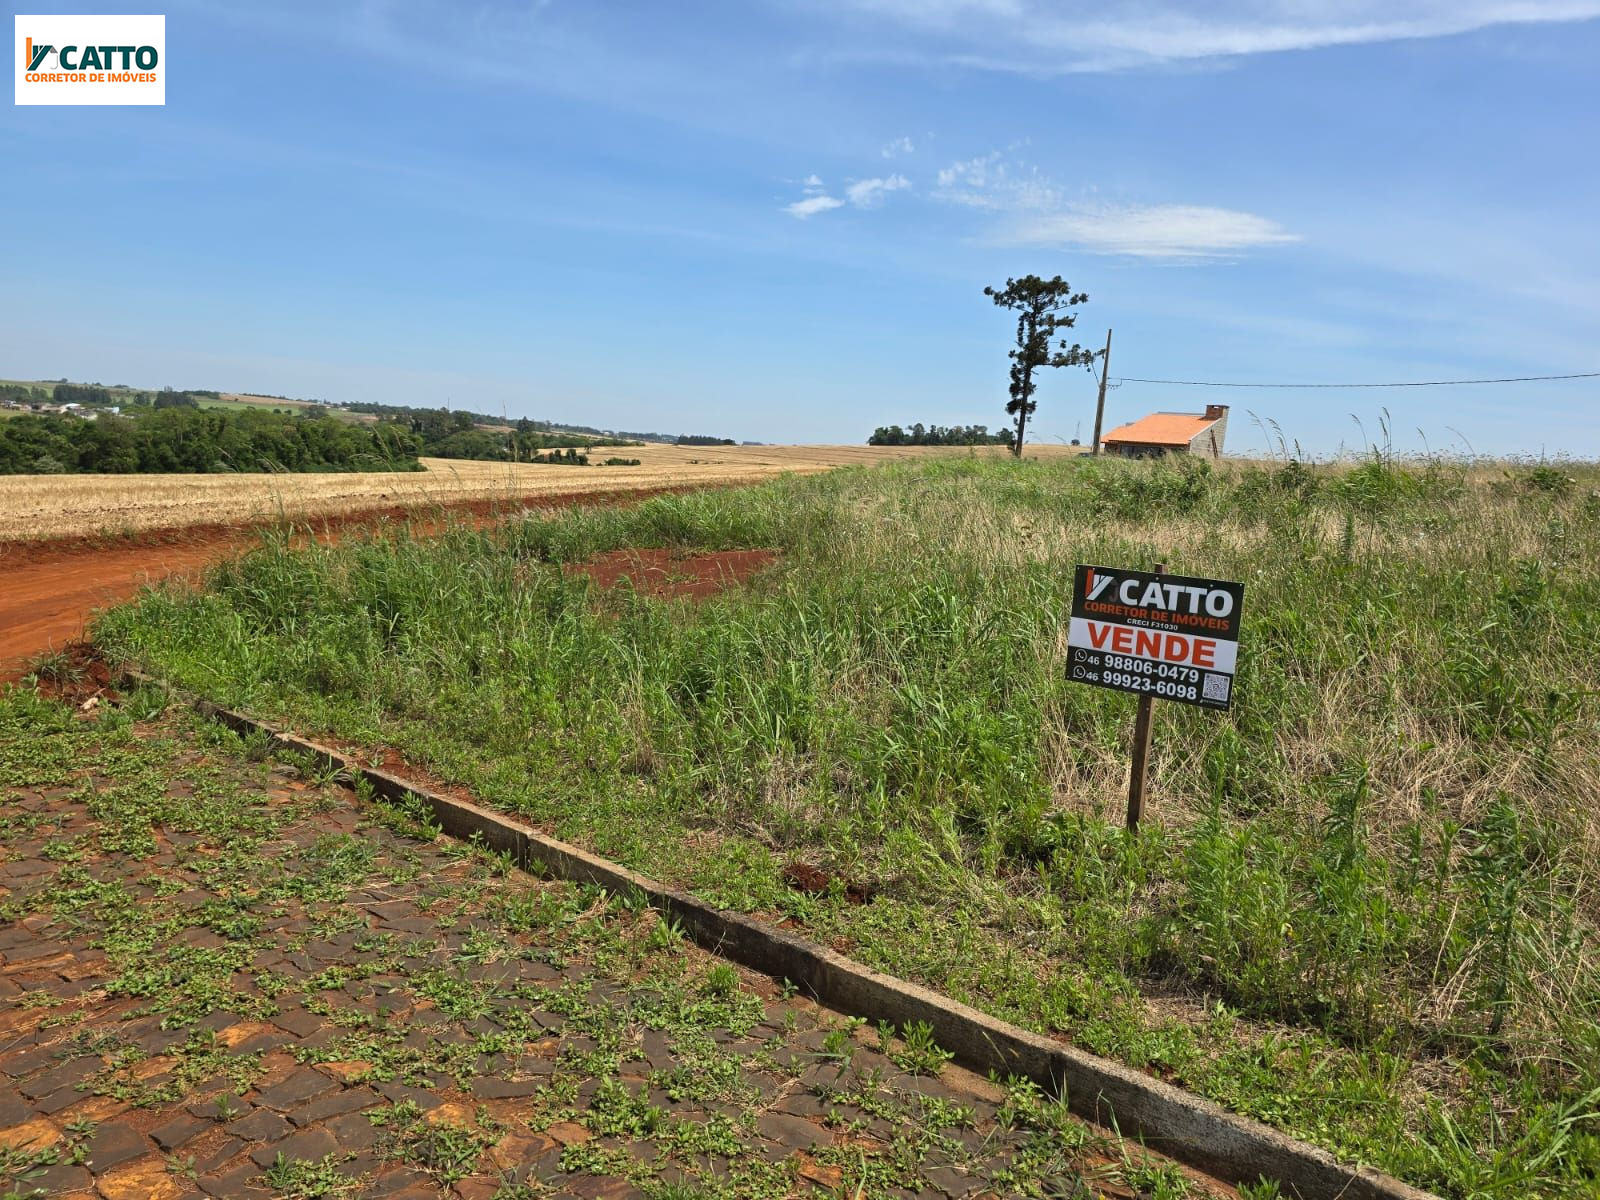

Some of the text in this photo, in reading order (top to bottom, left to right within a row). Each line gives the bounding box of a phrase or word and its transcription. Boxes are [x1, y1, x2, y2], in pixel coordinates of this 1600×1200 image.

[1119, 579, 1233, 617] CATTO
[1084, 601, 1230, 630] CORRETOR DE IMÓVEIS
[1127, 618, 1150, 627] CRECI
[1087, 622, 1216, 668] VENDE
[1087, 654, 1199, 683] 46 98806-0479
[1085, 671, 1197, 700] 46 99923-6098
